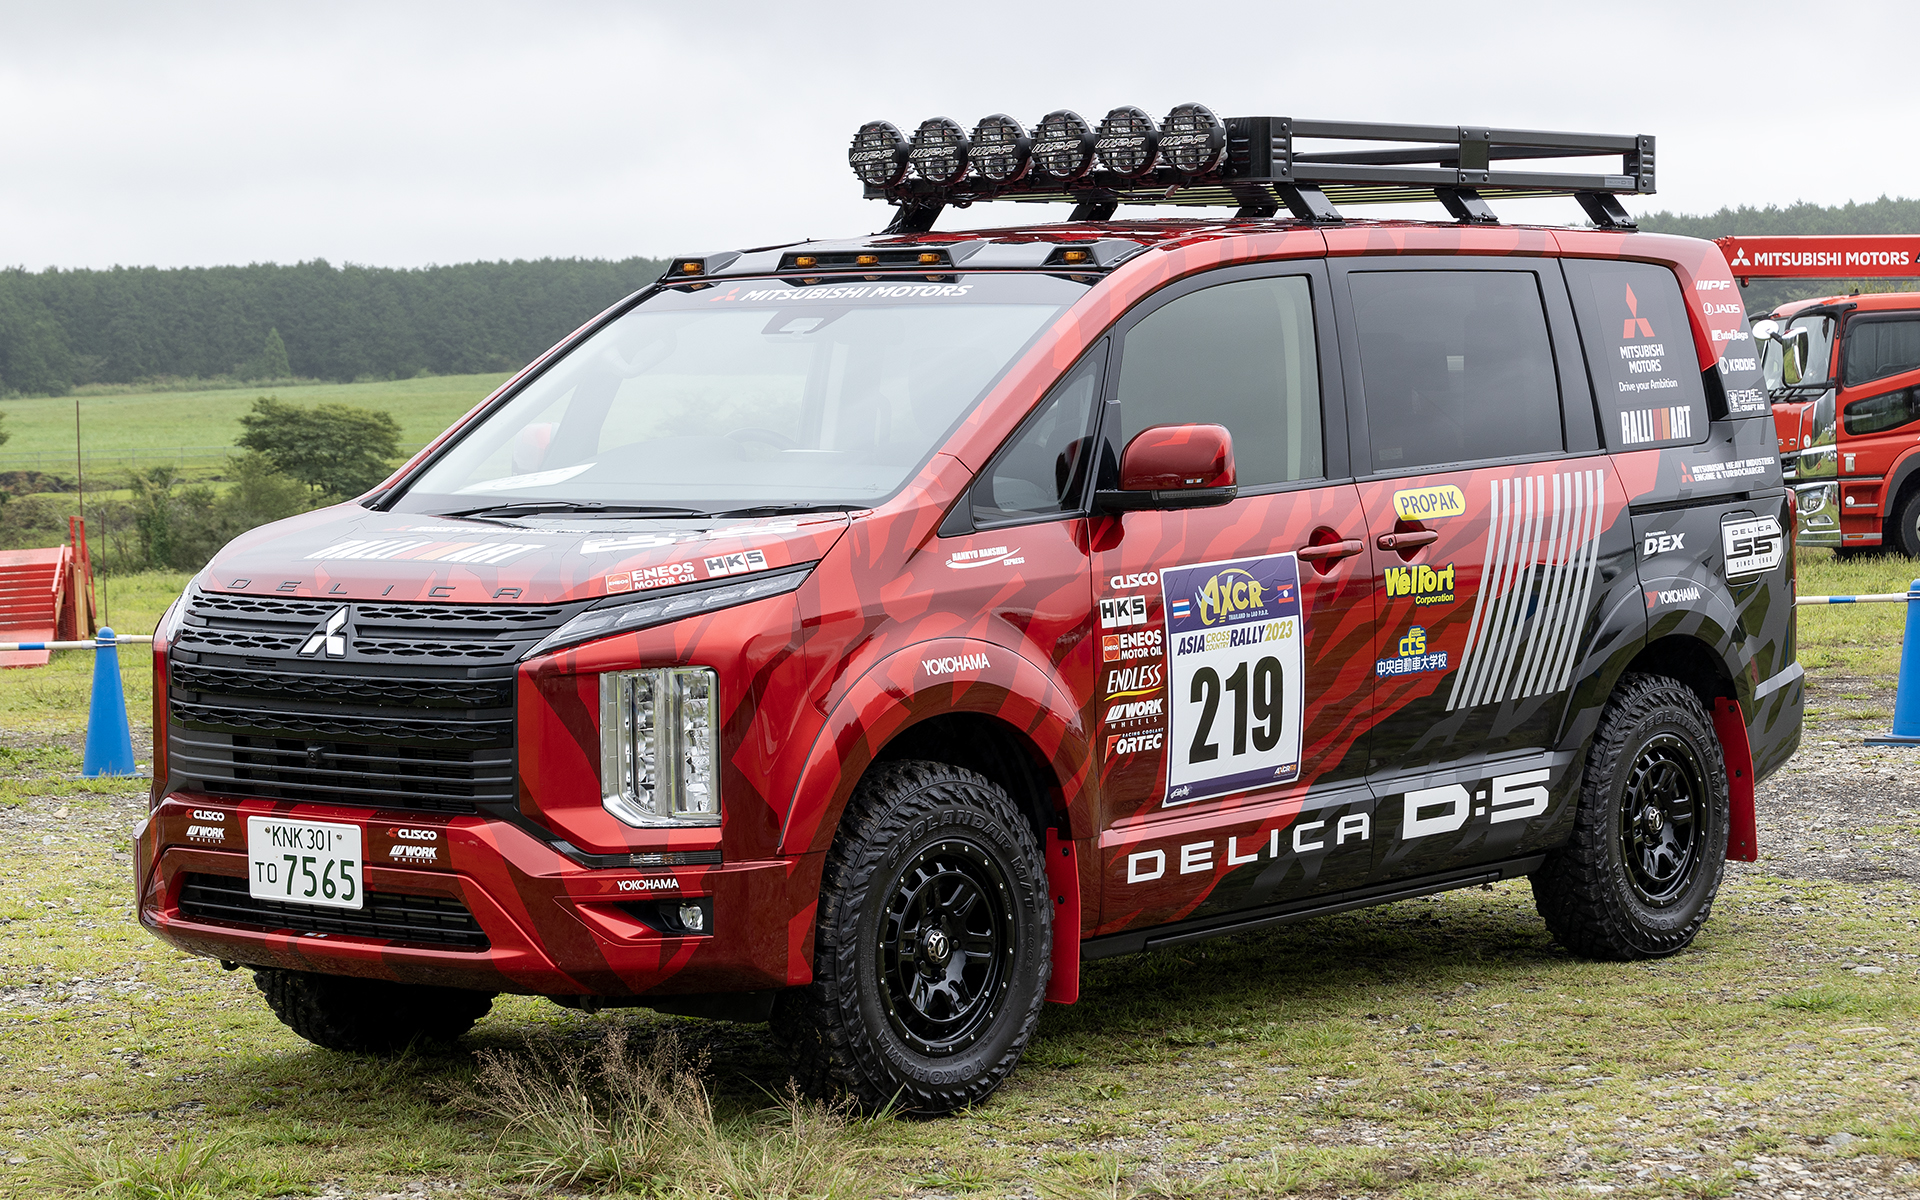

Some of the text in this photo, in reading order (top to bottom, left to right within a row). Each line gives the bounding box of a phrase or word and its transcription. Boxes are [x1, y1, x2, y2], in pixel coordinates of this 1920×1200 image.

[1754, 251, 1910, 266] MITSUBISHI MOTORS
[740, 284, 974, 301] MITSUBISHI MOTORS
[1619, 344, 1665, 359] MITSUBISHI
[1628, 359, 1662, 373] MOTORS
[1619, 378, 1678, 393] Drive your Ambition
[1691, 456, 1775, 474] MITSUBISHI HEAVY INDUSTRIES
[1694, 471, 1716, 481] ENGINE
[1722, 466, 1766, 478] TURBOCHARGER
[1400, 491, 1460, 515] PROPAK
[1731, 525, 1772, 536] DELICA
[1643, 532, 1685, 556] DEX
[706, 550, 765, 571] HKS
[952, 546, 1008, 561] HANKYU HANSHIN
[1003, 557, 1026, 566] EXPRESS
[632, 562, 695, 582] ENEOS
[1110, 572, 1158, 589] CUSCO
[227, 578, 523, 599] DELICA
[608, 578, 629, 586] ENEOS
[634, 573, 698, 590] MOTOR OIL
[1200, 574, 1265, 626] AXCR
[1415, 593, 1454, 605] Corporation
[1658, 587, 1701, 605] YOKOHAMA
[1101, 598, 1145, 619] HKS
[1120, 629, 1162, 649] ENEOS
[1177, 620, 1294, 657] ASIA CROSS RALLY 2023
[1205, 641, 1230, 651] COUNTRY
[1104, 644, 1119, 652] ENEOS
[1121, 646, 1162, 660] MOTOR OIL
[922, 653, 991, 676] YOKOHAMA
[1377, 653, 1447, 676] 中央自動車大学校
[1106, 664, 1163, 694] ENDLESS
[1124, 698, 1164, 718] WORK
[1189, 655, 1283, 765] 219
[1110, 716, 1158, 730] WHEELS
[1402, 769, 1551, 840] D:5
[193, 809, 225, 822] CUSCO
[198, 826, 226, 838] WORK
[272, 825, 332, 852] KNK 301
[397, 828, 438, 841] CUSCO
[887, 809, 1013, 870] GEOLANDAR
[402, 845, 438, 858] WORK
[1127, 811, 1370, 885] DELICA
[254, 853, 356, 901] TO 7565
[616, 878, 680, 891] YOKOHAMA
[876, 1029, 987, 1086] YOKOHAMA
